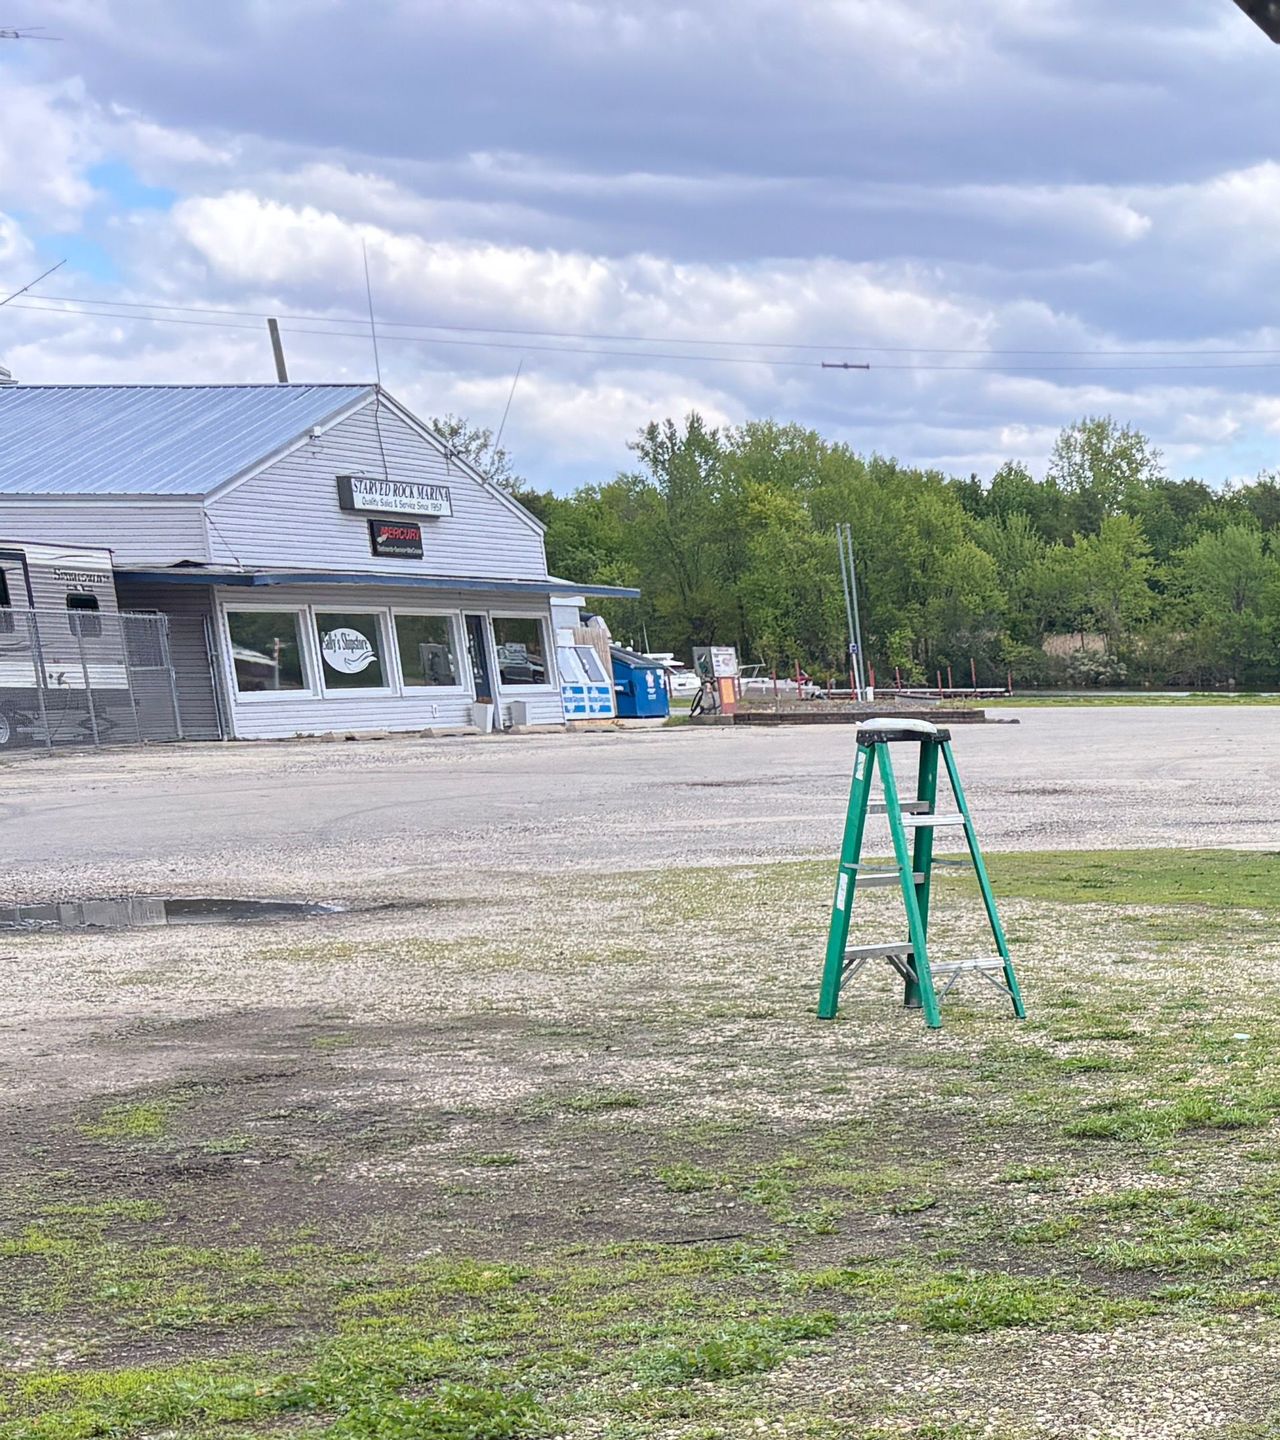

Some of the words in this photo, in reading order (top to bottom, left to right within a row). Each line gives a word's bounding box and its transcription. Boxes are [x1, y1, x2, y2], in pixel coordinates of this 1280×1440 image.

[353, 479, 391, 497] STARVED
[393, 482, 415, 499] ROCK
[416, 485, 449, 502] MARINA
[399, 500, 415, 509] Service
[379, 526, 420, 541] MERCURY
